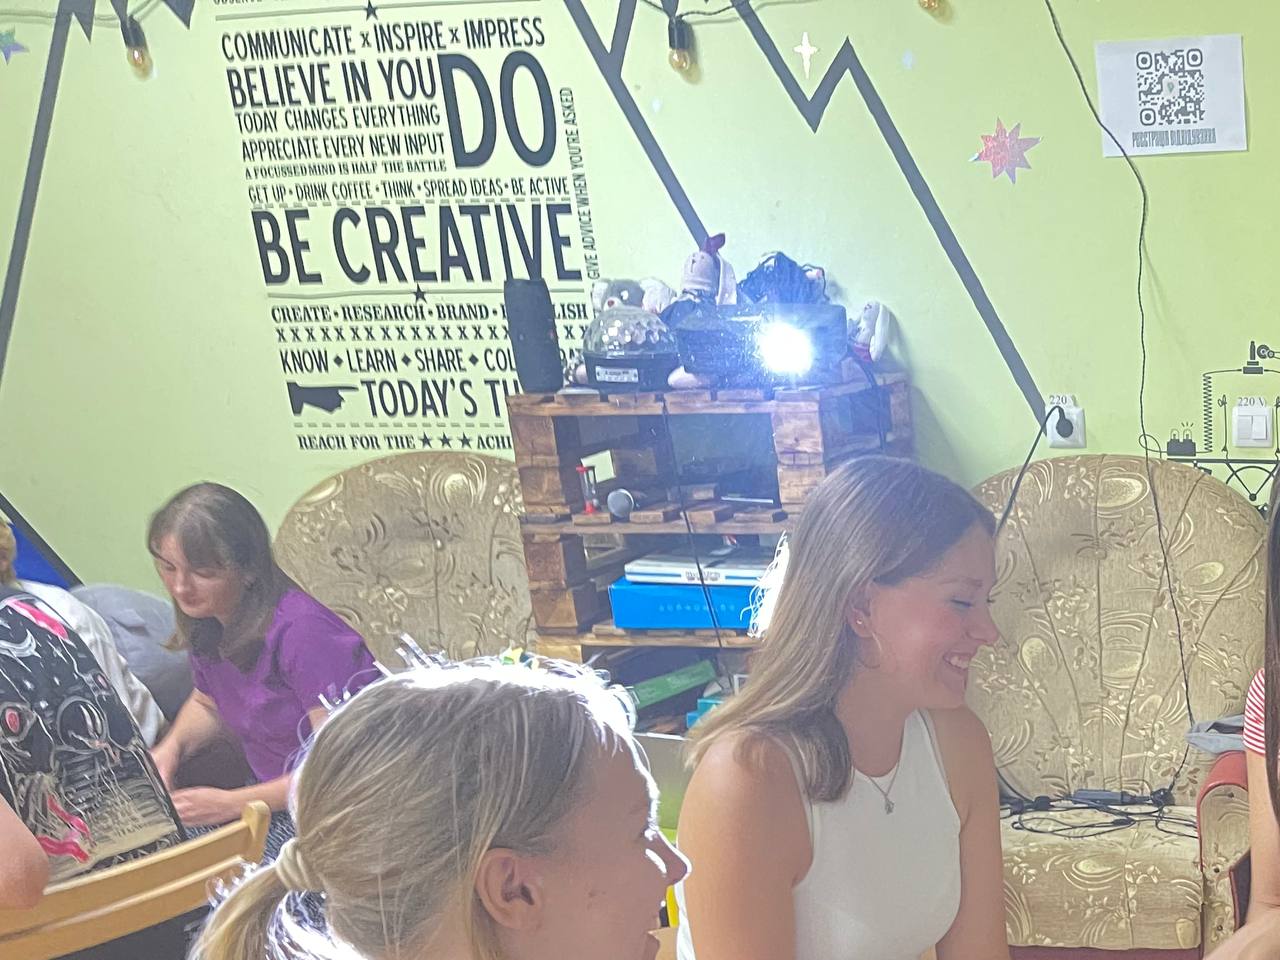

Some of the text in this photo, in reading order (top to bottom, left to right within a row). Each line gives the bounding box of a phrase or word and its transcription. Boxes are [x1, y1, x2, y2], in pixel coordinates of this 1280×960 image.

[222, 25, 355, 62] COMMUNICATE
[374, 20, 446, 53] INSPIRE
[464, 17, 545, 49] IMPRESS
[226, 57, 436, 109] BELIEVE IN YOU
[235, 103, 441, 134] TODAY CHANGES EVERYTHING
[437, 50, 557, 168] DO
[560, 87, 578, 126] ASKED
[242, 132, 445, 162] APPRECIATE EVERY NEW INPUT
[245, 158, 447, 180] A FOCUSSED MIND IS HALF THE BATTLE
[248, 175, 570, 204] GET UP DRINK COFFEE THINK SPREAD IDEAS BE ACTIVE
[572, 172, 589, 209] WHEN
[251, 203, 583, 286] BE CREATIVE
[578, 209, 597, 251] ADVICE
[584, 253, 600, 280] GIVE
[271, 304, 332, 323] CREATE
[341, 303, 426, 322] RESEARCH
[436, 303, 490, 321] BRAND
[279, 349, 329, 375] KNOW
[347, 348, 398, 373] LEARN
[414, 348, 467, 372] SHARE
[360, 379, 478, 418] TODAY'S
[1049, 395, 1067, 405] 220
[1238, 397, 1255, 407] 220
[297, 434, 512, 450] REACH FOR THE ACHI
